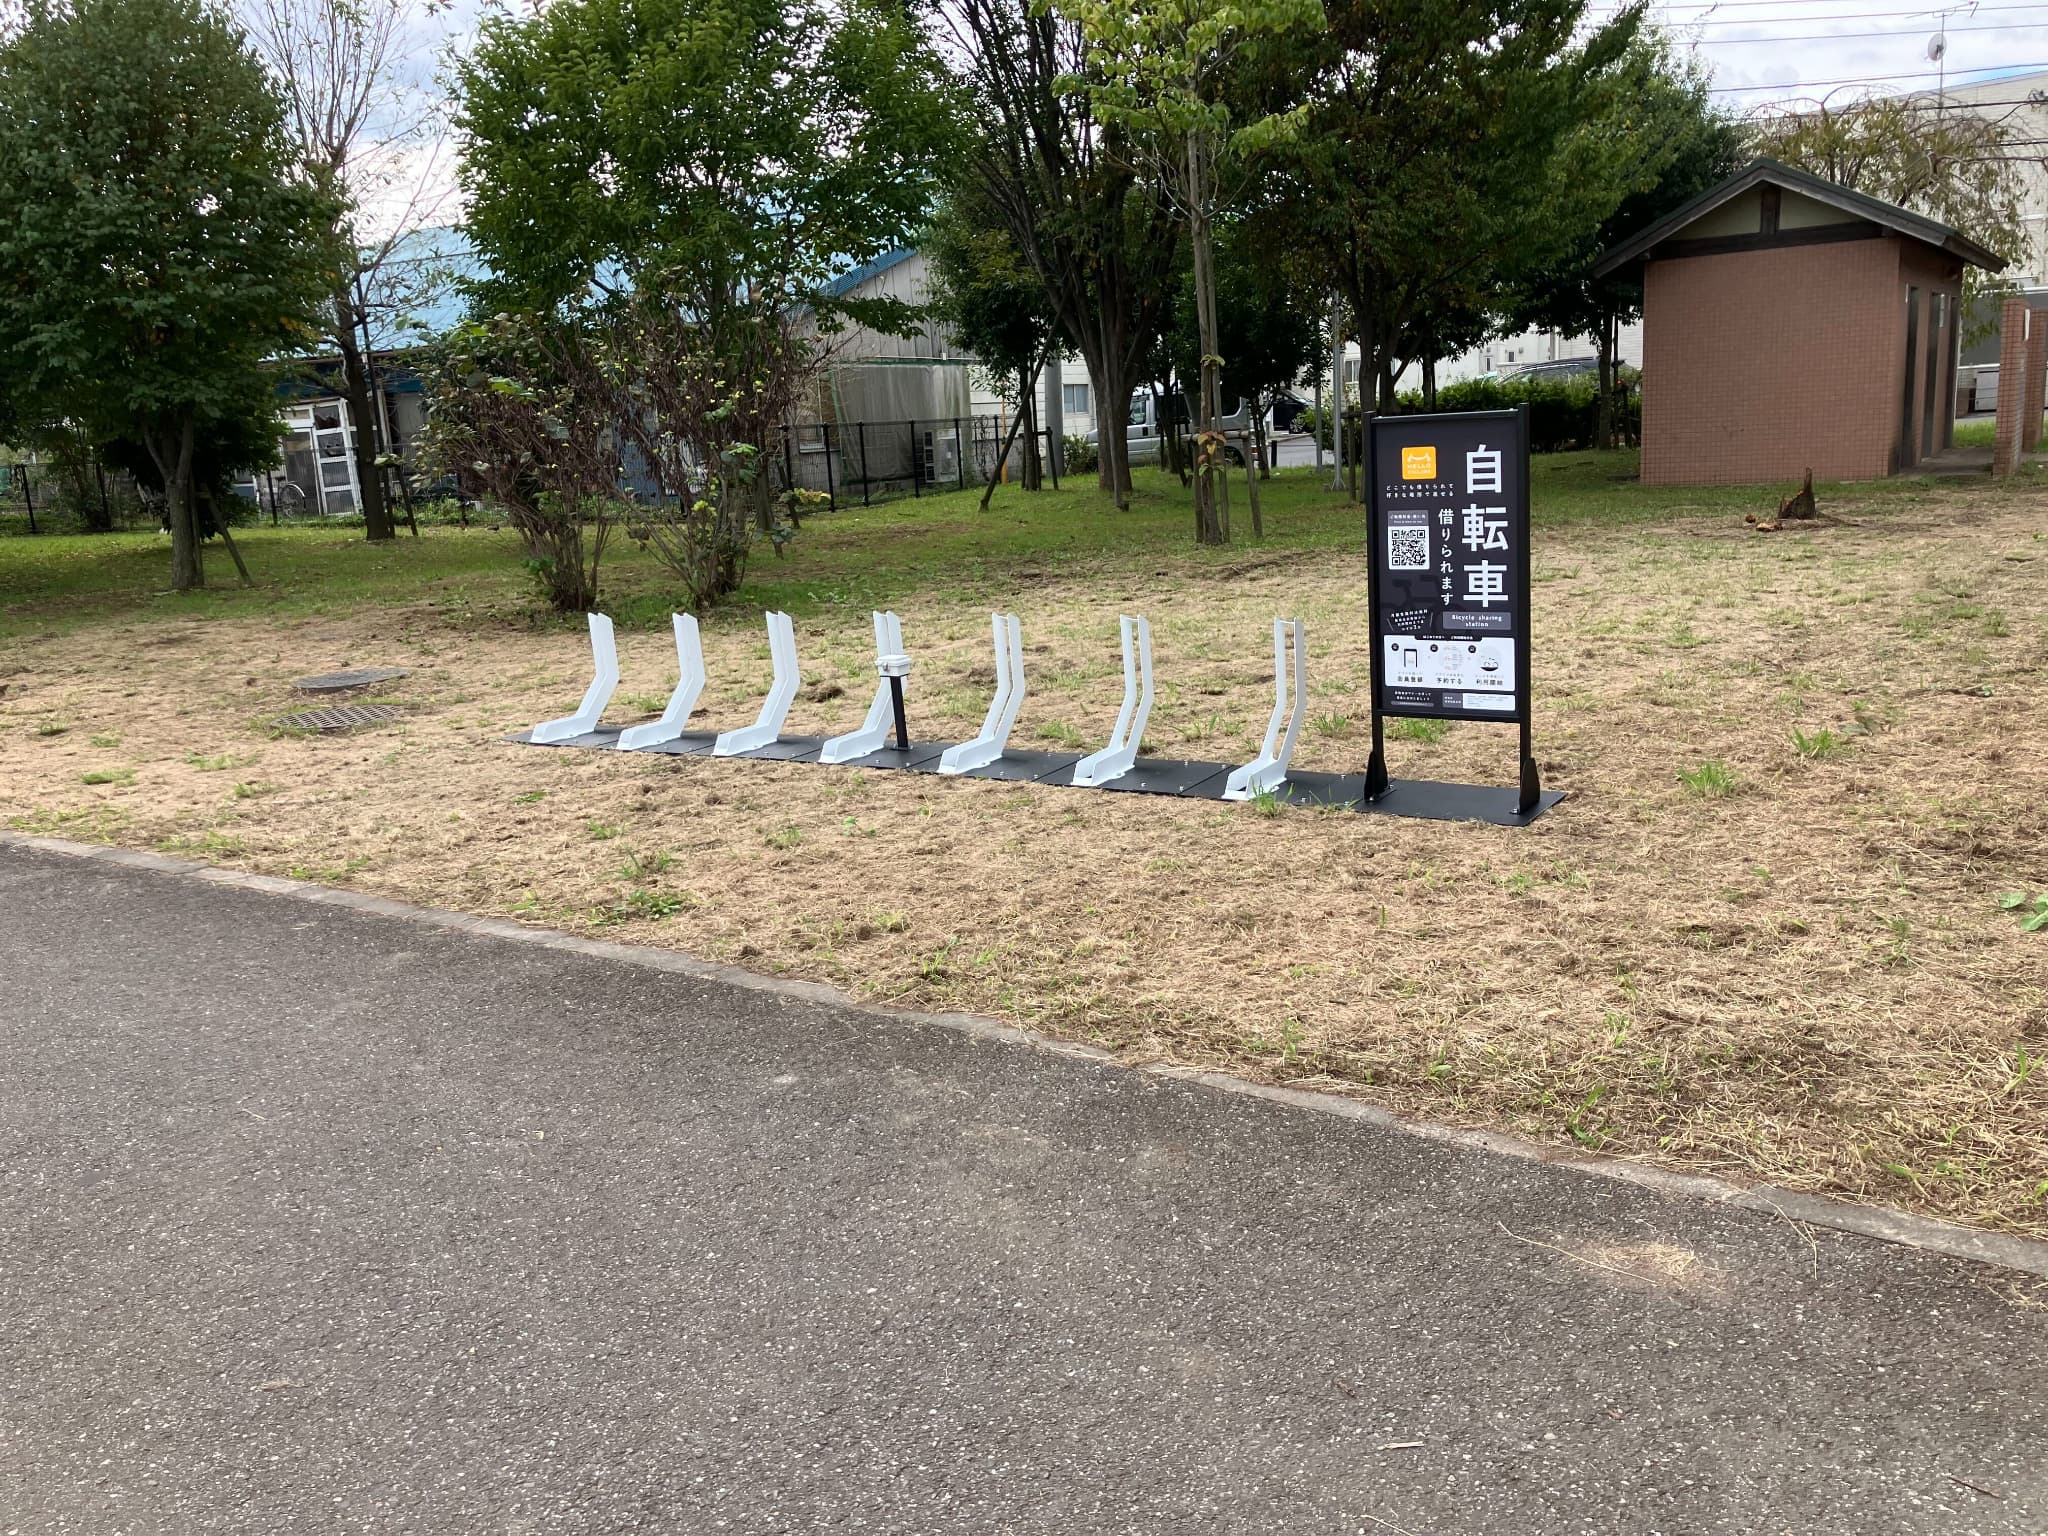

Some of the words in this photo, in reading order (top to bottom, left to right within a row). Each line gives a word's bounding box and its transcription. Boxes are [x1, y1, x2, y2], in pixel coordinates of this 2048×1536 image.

[1461, 444, 1509, 608] 自転車
[1438, 508, 1455, 606] 借りられます
[1451, 614, 1475, 622] Bicycle
[1478, 614, 1503, 623] sharing
[1436, 677, 1464, 685] 予約する
